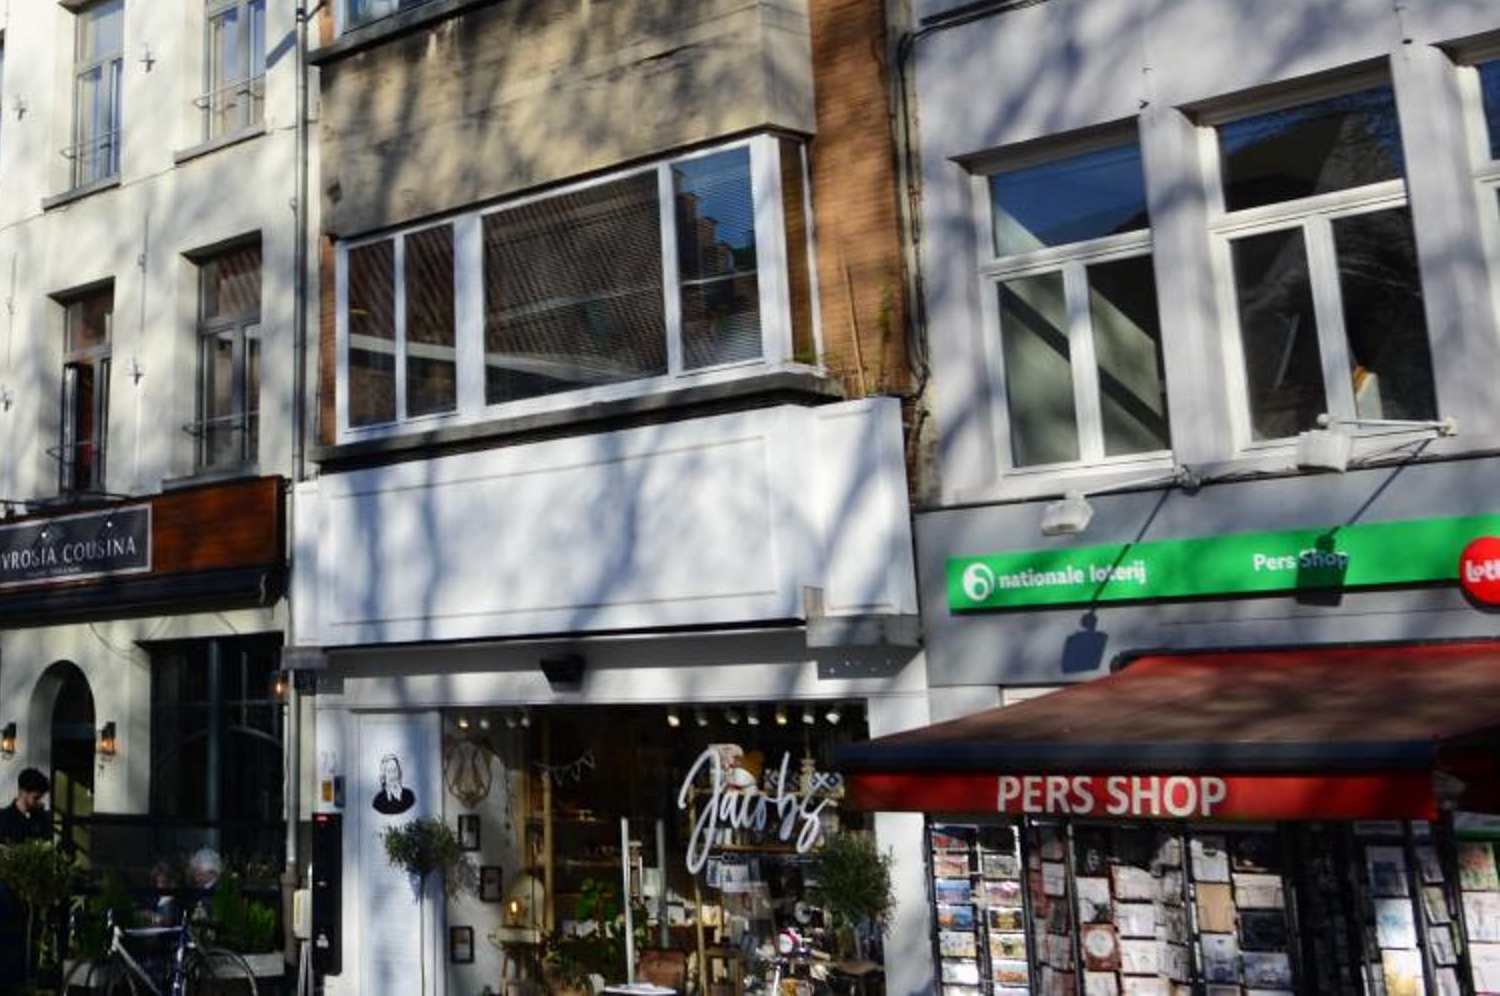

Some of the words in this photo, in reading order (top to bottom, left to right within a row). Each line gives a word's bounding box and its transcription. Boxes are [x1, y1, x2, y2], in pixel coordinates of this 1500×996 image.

[63, 536, 136, 563] COUSINA
[1253, 552, 1296, 572] Pers
[1300, 548, 1349, 569] Shop
[1000, 564, 1084, 589] nationale
[1090, 559, 1146, 586] loterij
[997, 775, 1094, 813] PERS
[1106, 776, 1227, 817] SHOP
